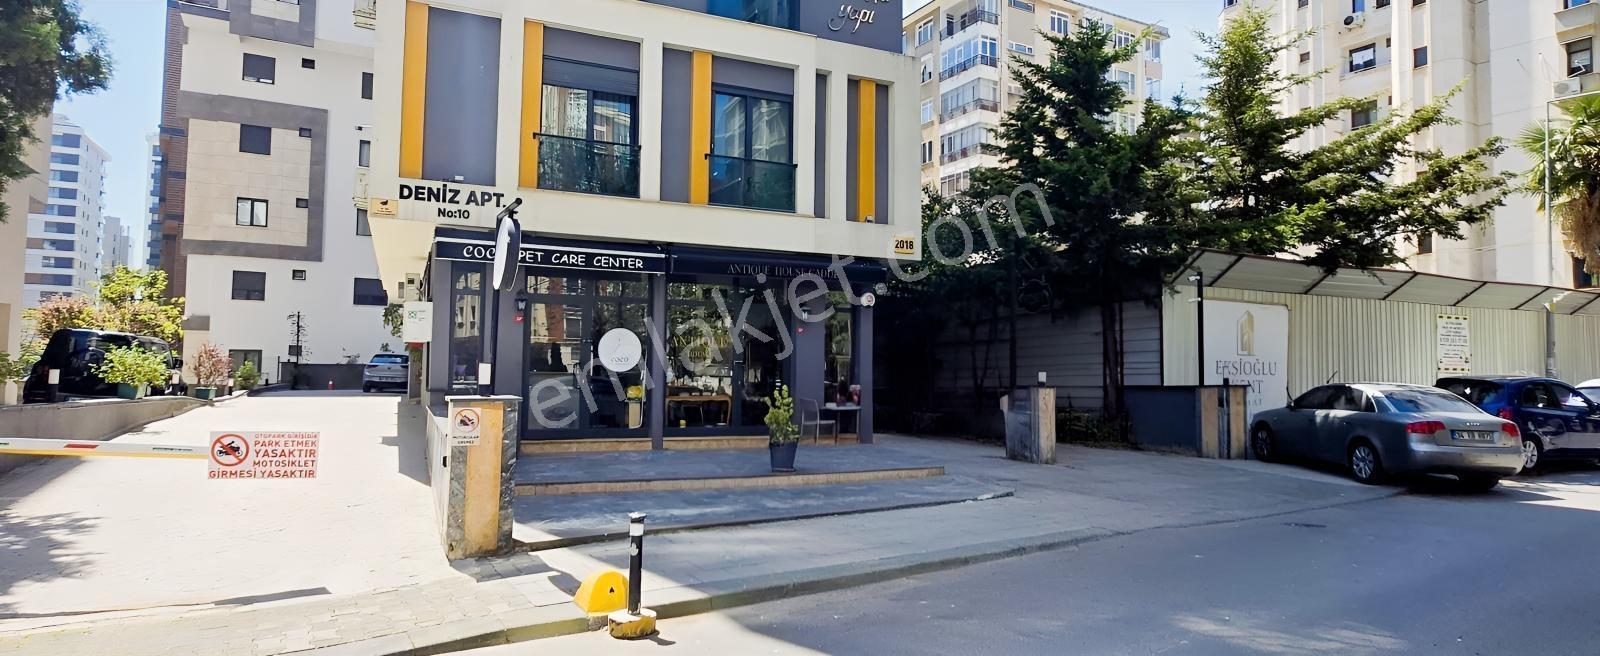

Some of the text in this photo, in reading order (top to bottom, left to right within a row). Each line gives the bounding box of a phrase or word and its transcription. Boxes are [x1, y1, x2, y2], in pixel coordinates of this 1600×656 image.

[828, 4, 875, 33] yapı
[398, 184, 507, 209] DENİZ APT.
[437, 206, 470, 220] No:10
[894, 239, 914, 250] 2018
[518, 251, 544, 263] PET
[551, 252, 586, 266] CARE
[593, 255, 644, 270] CENTER
[254, 440, 317, 448] PARK ETMEK
[254, 449, 316, 458] YASAKTIR
[209, 468, 315, 479] GİRMESİ YASAKTIR
